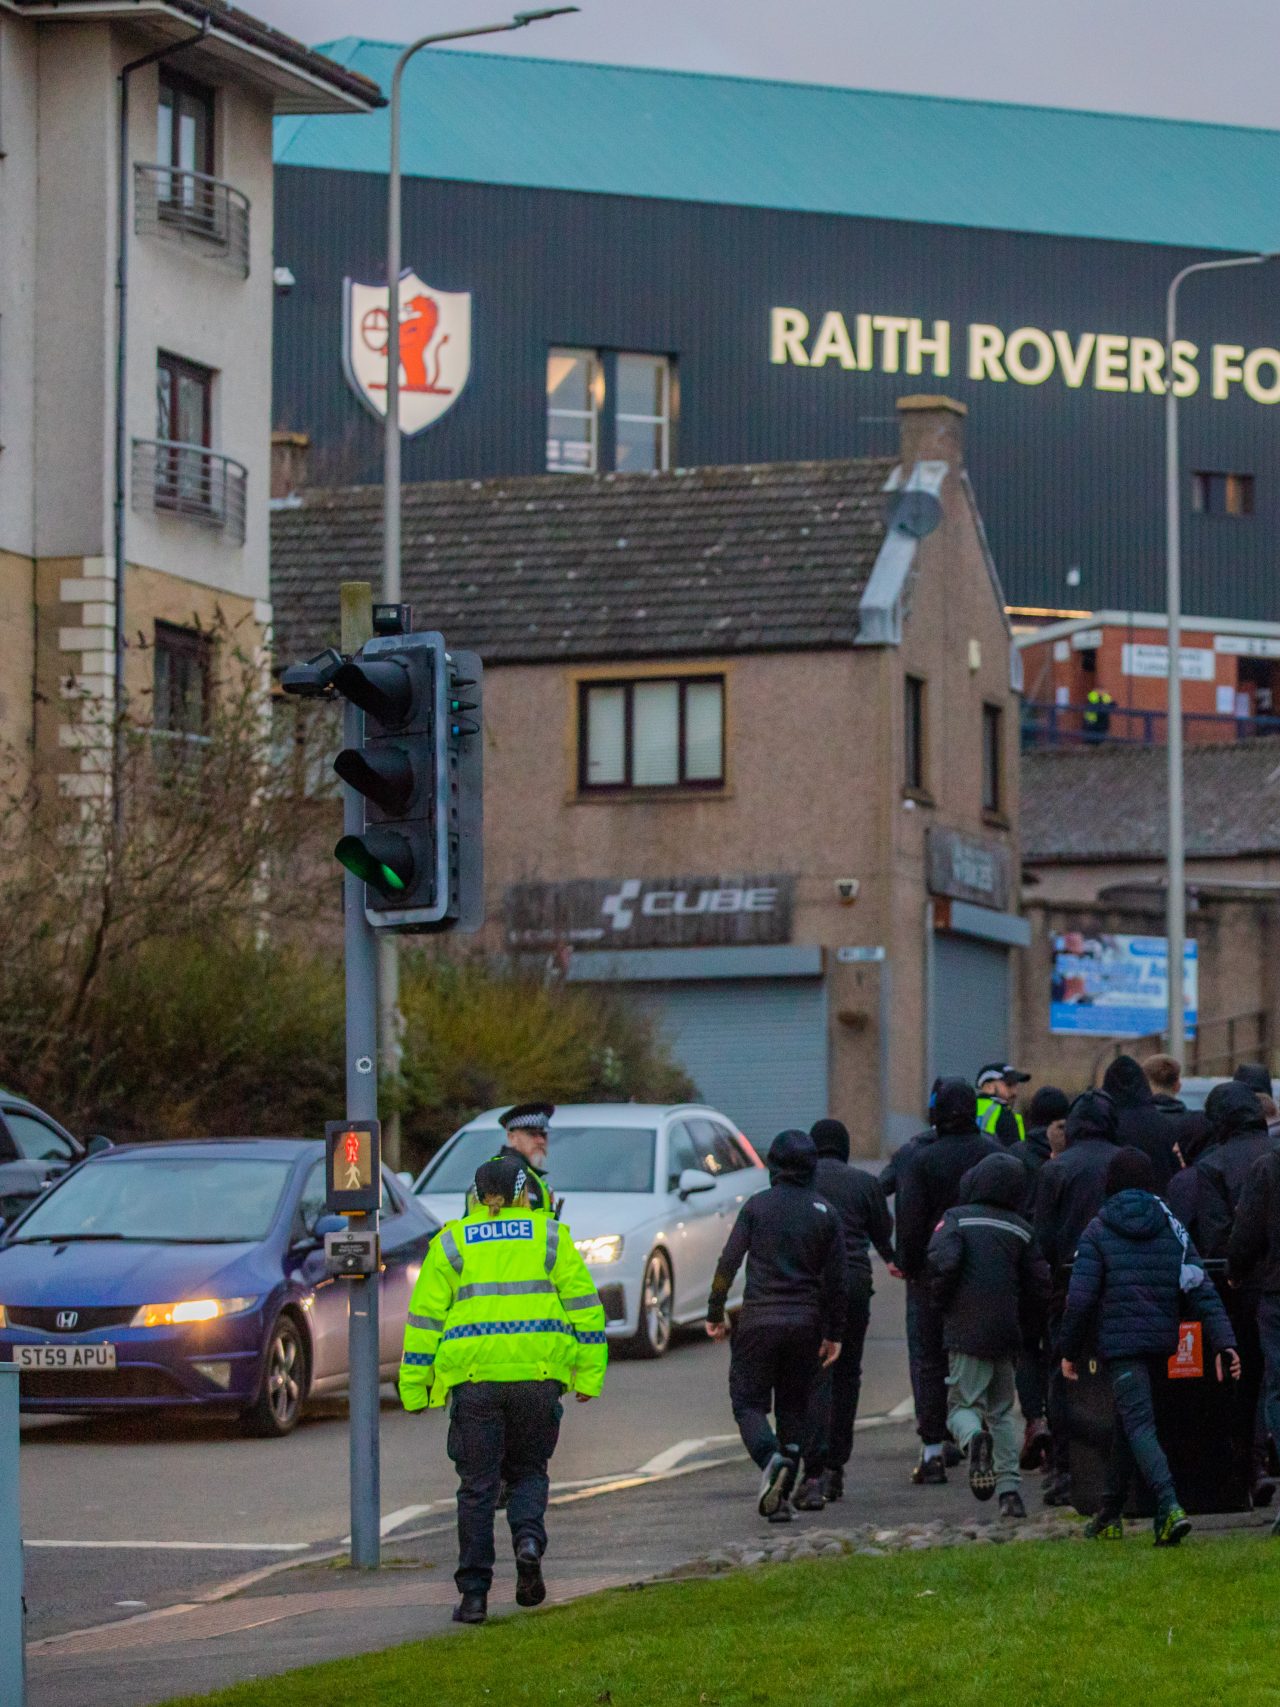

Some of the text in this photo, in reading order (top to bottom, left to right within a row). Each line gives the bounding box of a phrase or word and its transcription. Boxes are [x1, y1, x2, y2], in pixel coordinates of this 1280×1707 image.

[770, 306, 950, 377] RAITH
[968, 323, 1200, 398] ROVERS
[641, 887, 778, 917] CUBE
[467, 1221, 530, 1241] POLICE
[21, 1348, 107, 1365] ST59 APU
